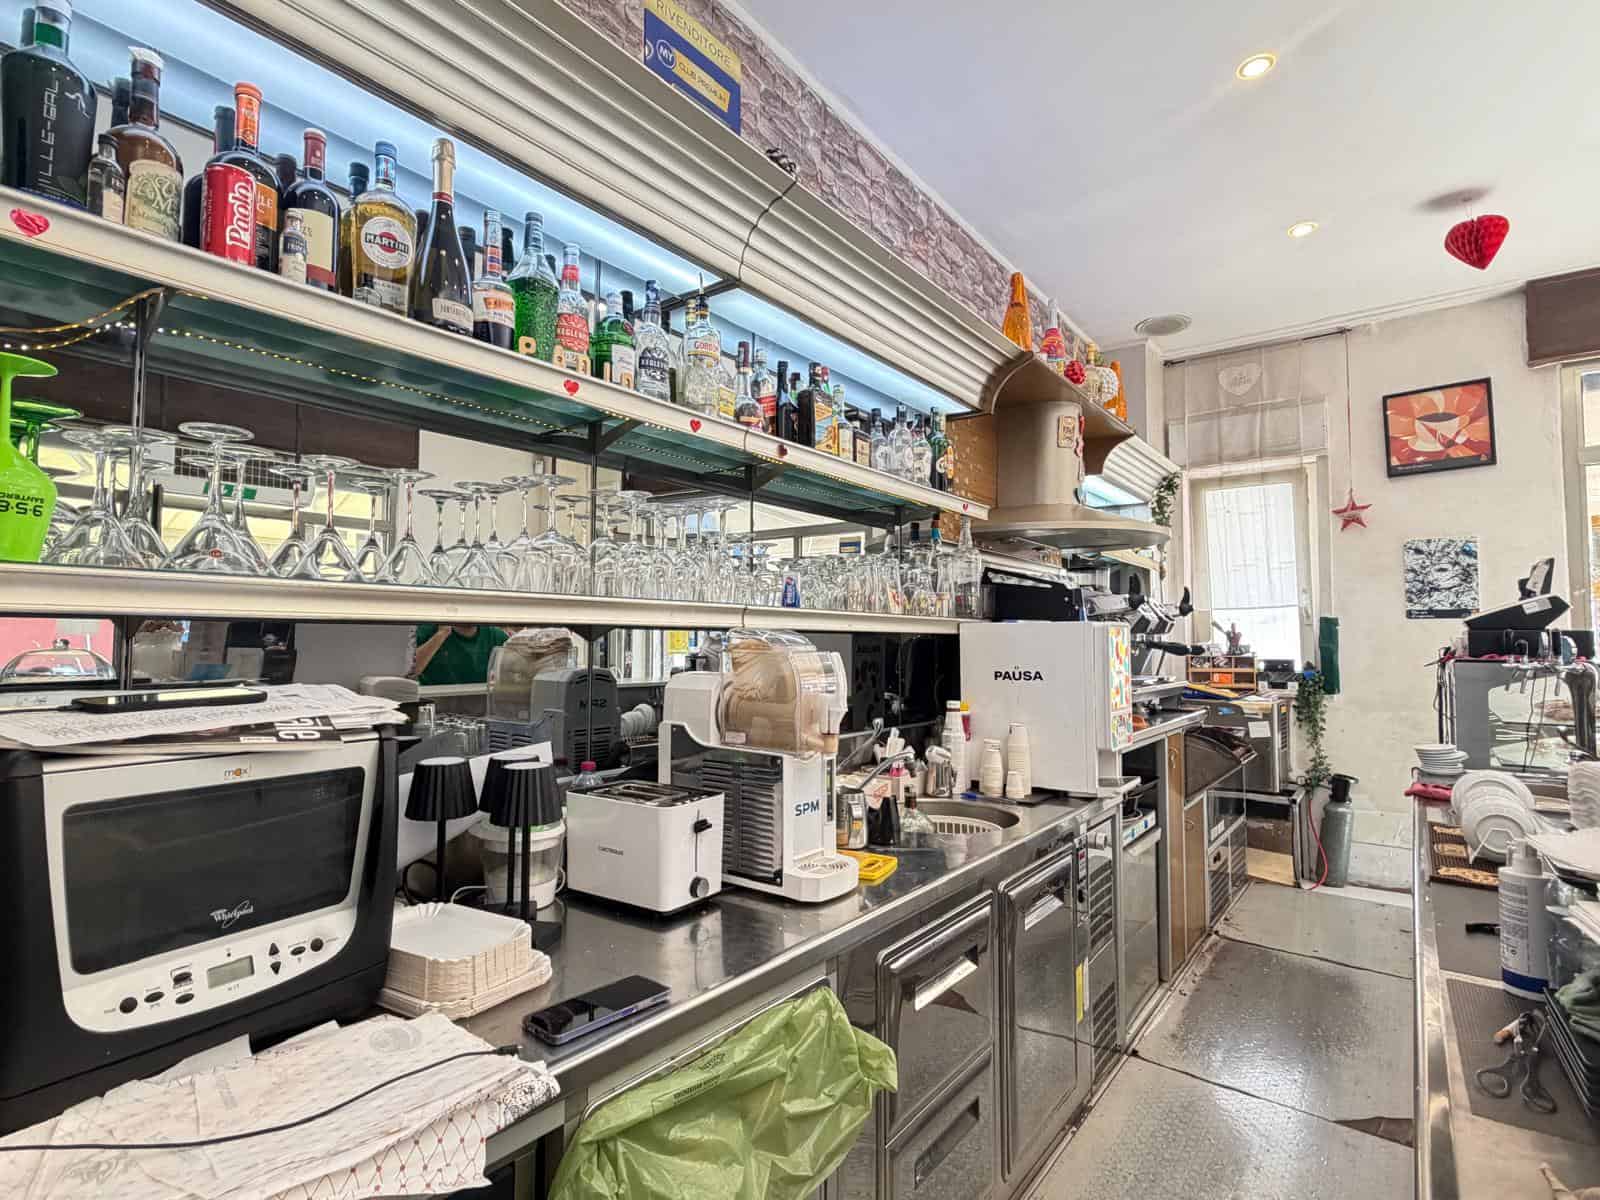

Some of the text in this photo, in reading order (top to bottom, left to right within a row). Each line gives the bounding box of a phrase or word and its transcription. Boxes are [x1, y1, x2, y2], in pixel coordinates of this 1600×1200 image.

[656, 0, 731, 66] RIVENDITORE
[364, 231, 409, 255] MARTINI
[794, 799, 820, 817] SPM
[210, 902, 254, 925] Whirlpool
